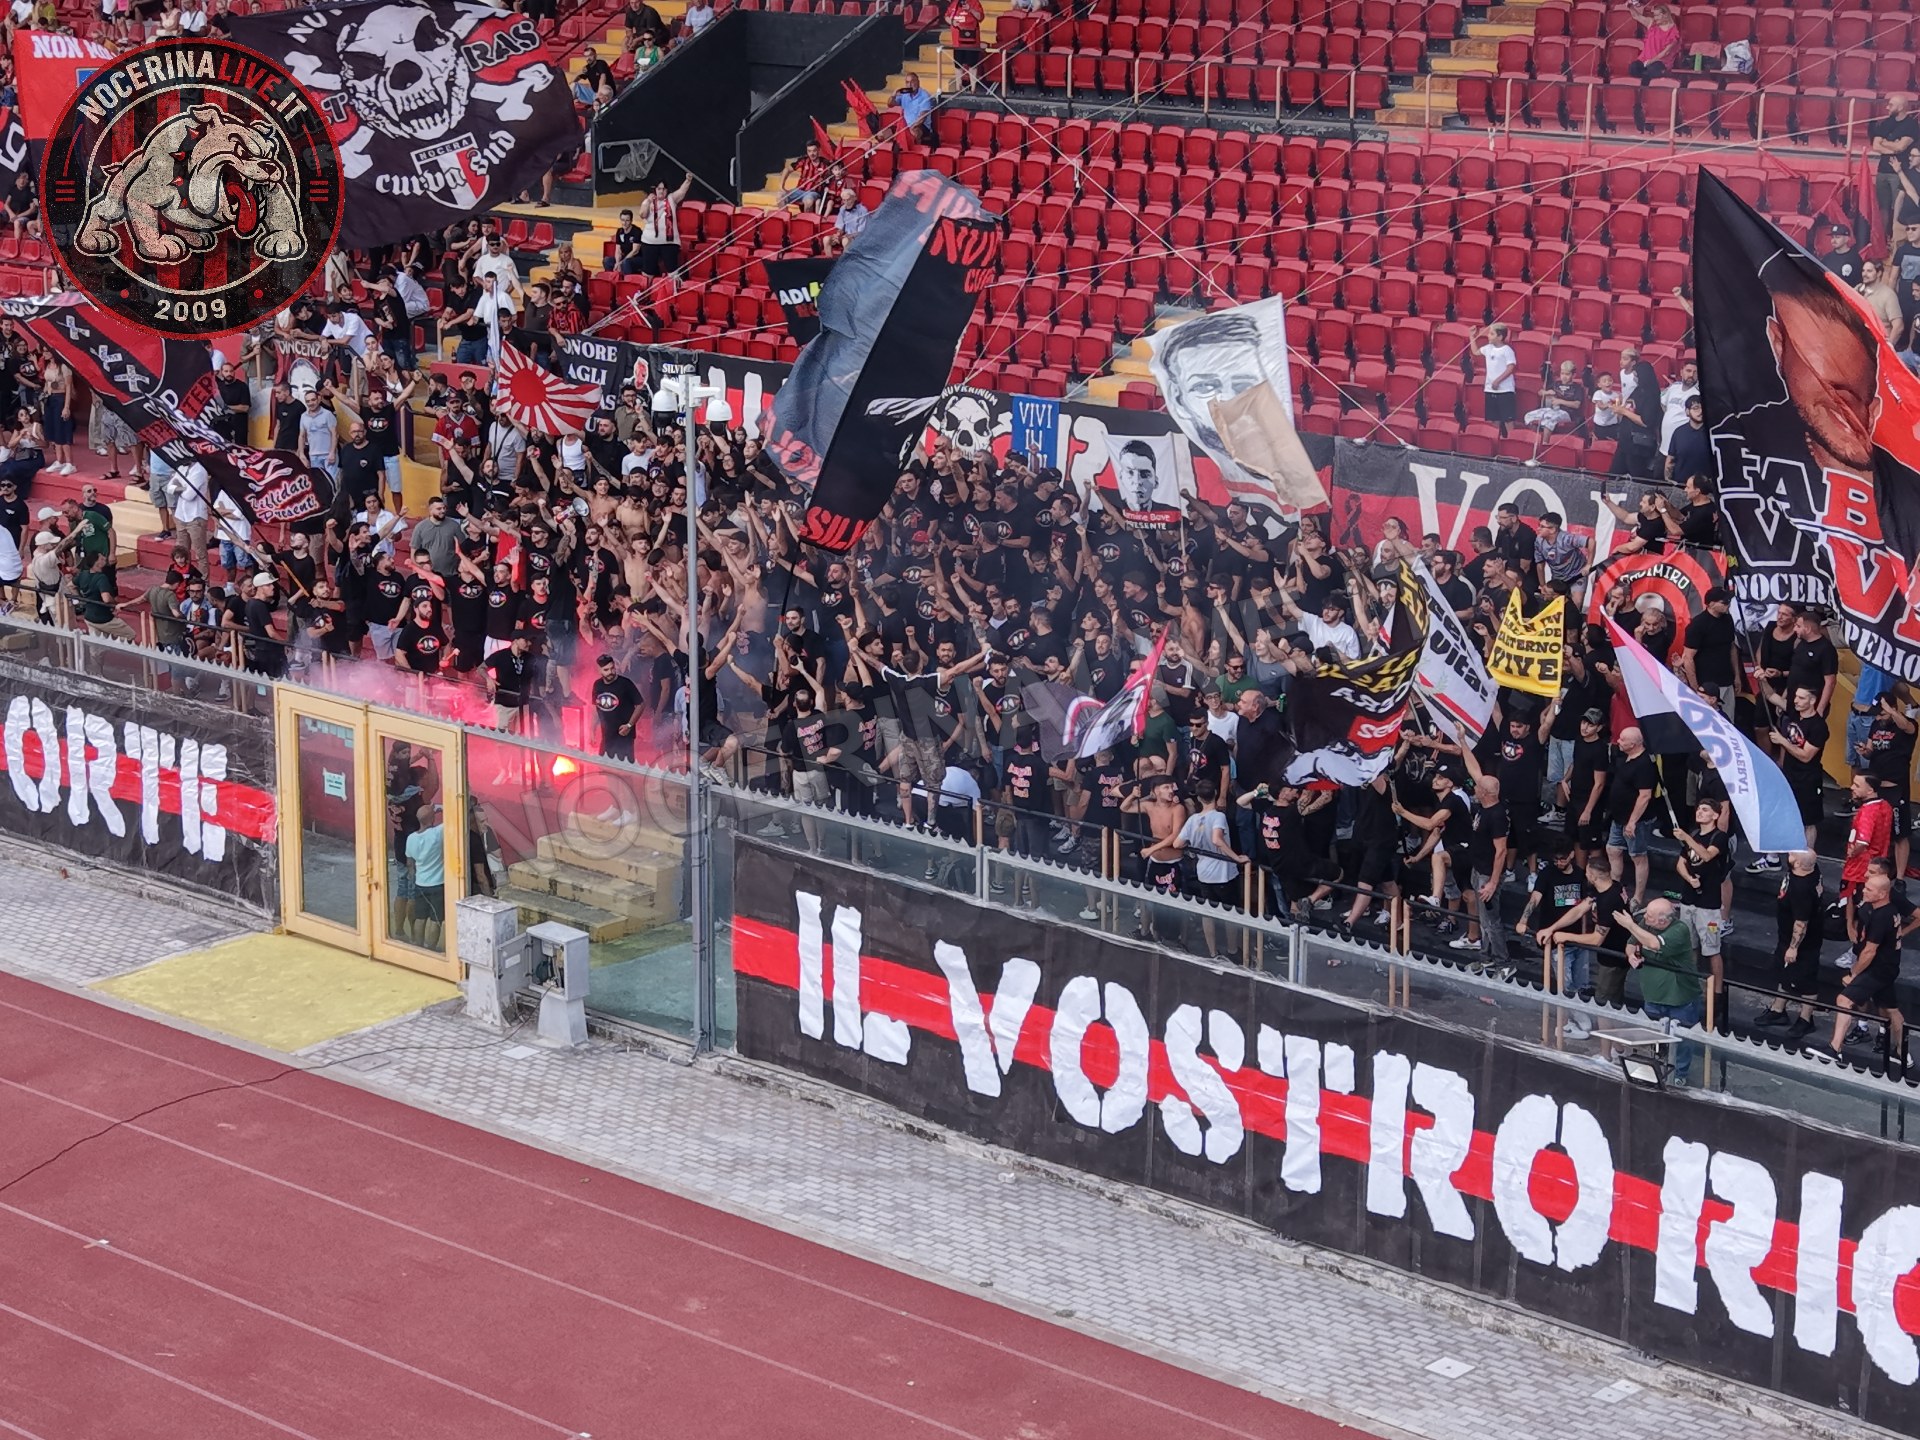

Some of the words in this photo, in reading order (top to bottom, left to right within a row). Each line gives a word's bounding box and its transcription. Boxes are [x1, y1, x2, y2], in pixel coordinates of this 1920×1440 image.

[31, 34, 84, 59] NON
[461, 20, 541, 72] RAS
[418, 138, 471, 161] NOCERA
[280, 339, 328, 359] VINCENZ
[562, 338, 618, 363] ONORE
[568, 363, 608, 386] AGLI
[1018, 401, 1053, 428] VIVI
[5, 695, 228, 862] ORTE
[795, 889, 911, 1066] IL
[934, 937, 1614, 1273] VOSTRO
